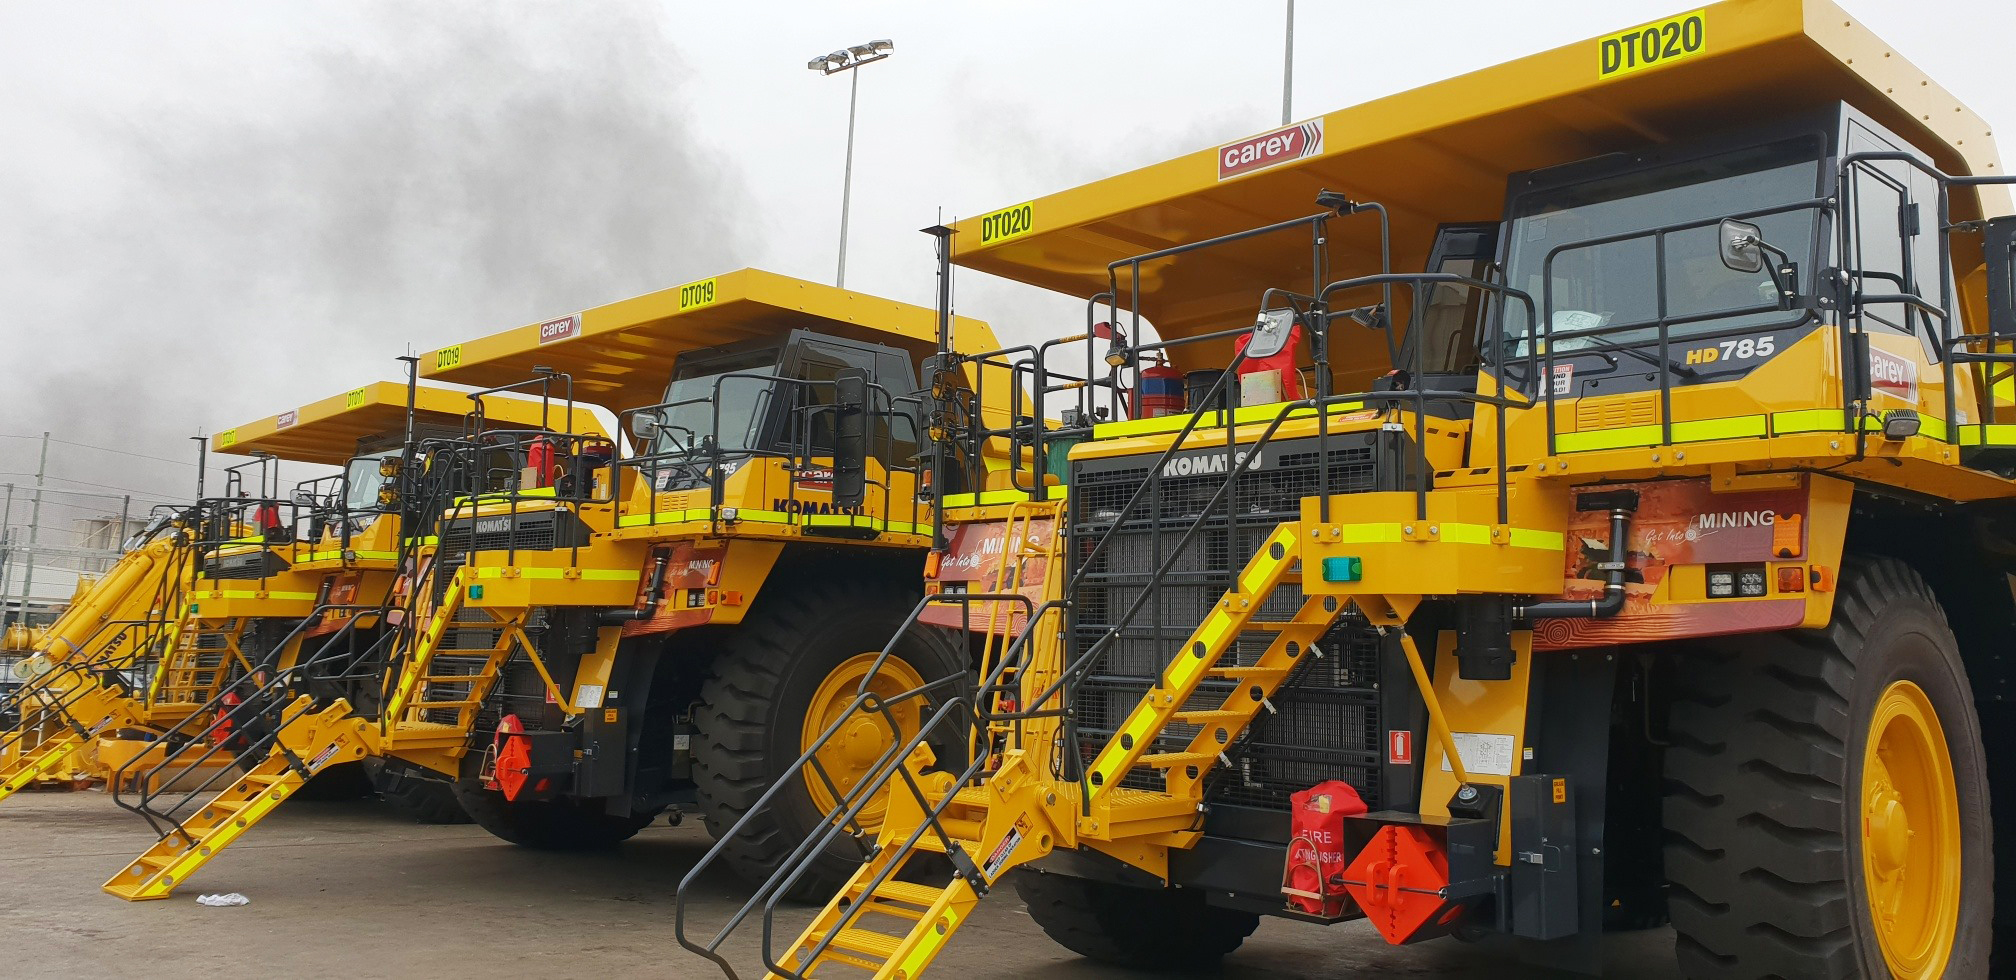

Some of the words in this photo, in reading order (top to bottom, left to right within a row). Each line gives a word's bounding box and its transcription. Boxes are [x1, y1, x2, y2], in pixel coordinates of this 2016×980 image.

[1602, 16, 1702, 75] DT020
[983, 205, 1031, 242] DT020
[682, 281, 714, 308] DT019
[437, 347, 460, 368] DT019
[347, 389, 364, 407] DT017
[1645, 529, 1663, 546] Get
[1700, 510, 1775, 529] MINING
[1302, 829, 1332, 844] FIRE
